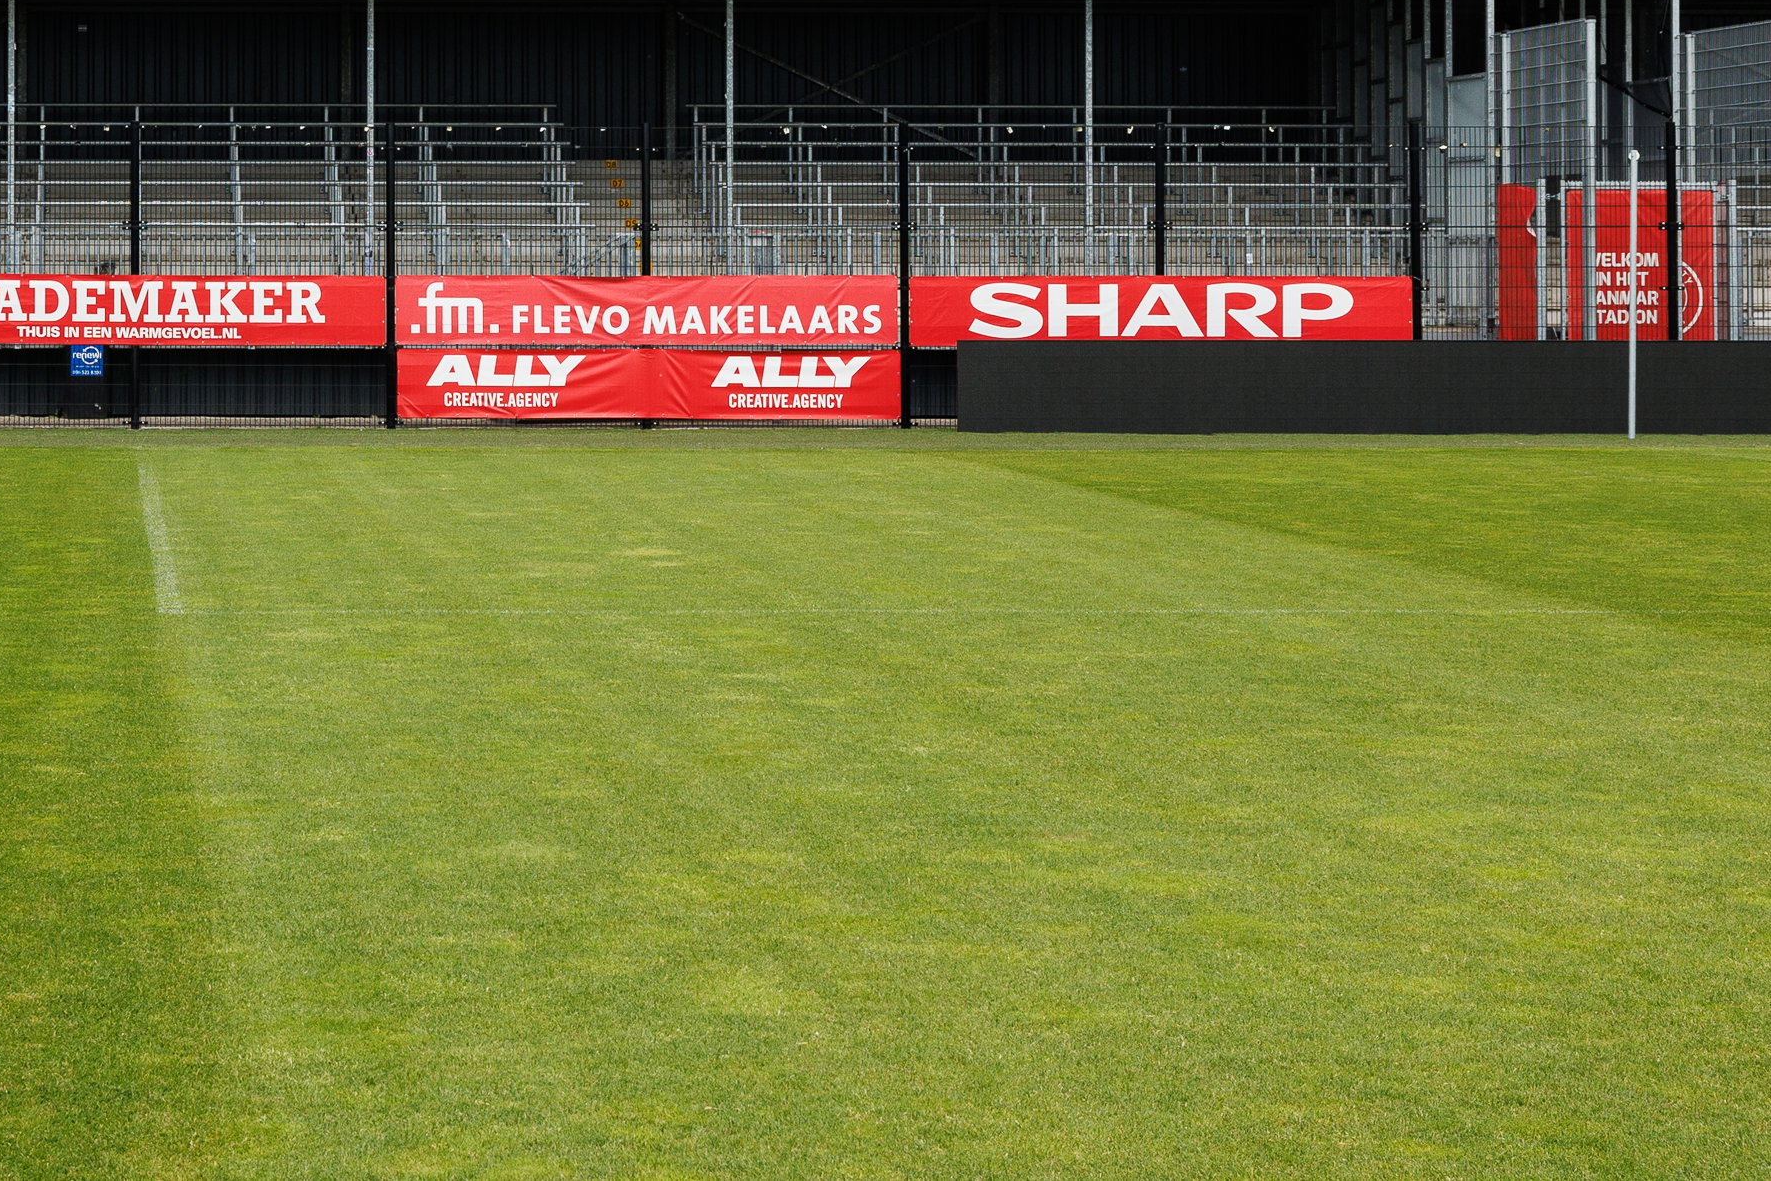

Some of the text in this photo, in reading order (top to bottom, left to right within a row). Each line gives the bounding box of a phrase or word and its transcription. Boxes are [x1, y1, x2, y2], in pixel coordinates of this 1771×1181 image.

[512, 304, 630, 335] FLEVO
[642, 304, 882, 335] MAKELAARS
[968, 282, 1354, 339] SHARP
[16, 325, 242, 339] THUIS IN EEN WARMGEVOEL.NL
[426, 354, 587, 387] ALLY
[710, 355, 872, 388] ALLY
[443, 391, 559, 408] CREATIVE.AGENCY
[728, 393, 844, 409] CREATIVE.AGENCY
